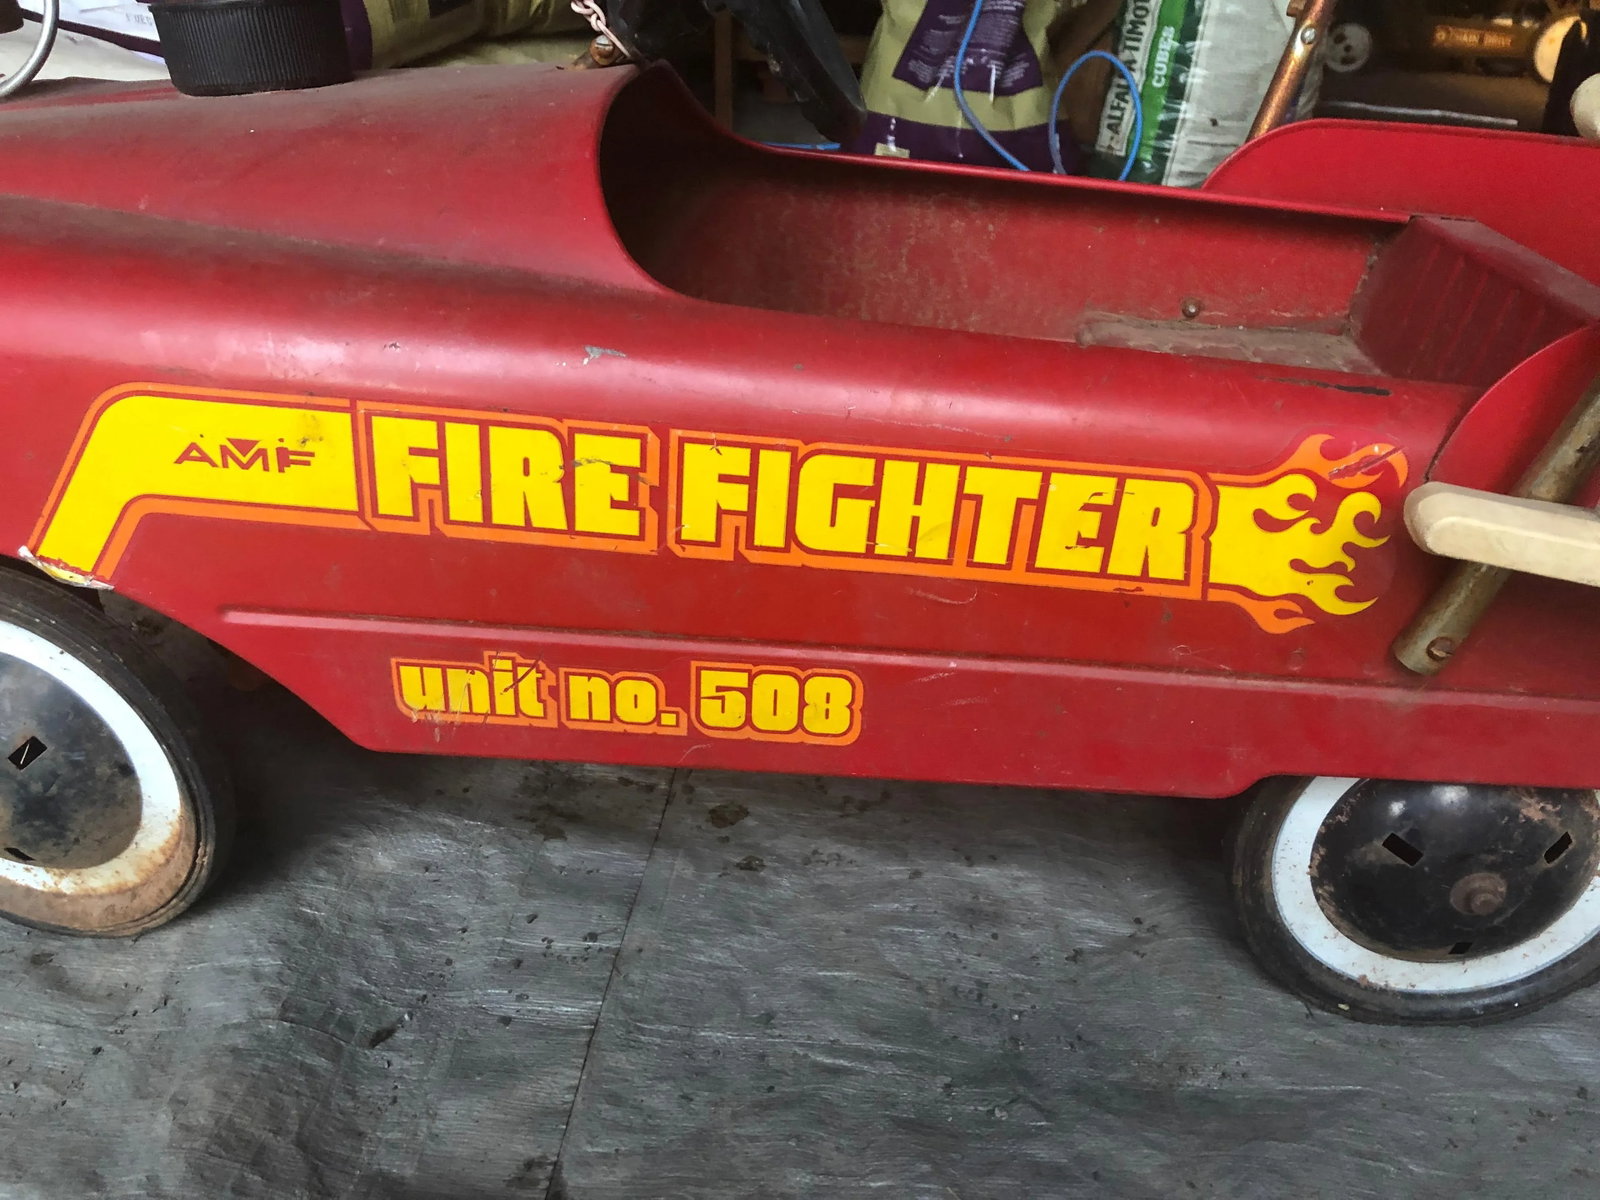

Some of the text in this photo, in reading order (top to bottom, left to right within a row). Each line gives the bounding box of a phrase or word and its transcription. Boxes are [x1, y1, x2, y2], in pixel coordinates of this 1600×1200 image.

[1151, 25, 1176, 88] CUBES
[173, 437, 316, 473] AMF
[370, 414, 1195, 581] FIRE FIGHTER
[399, 658, 853, 735] unit no. 508
